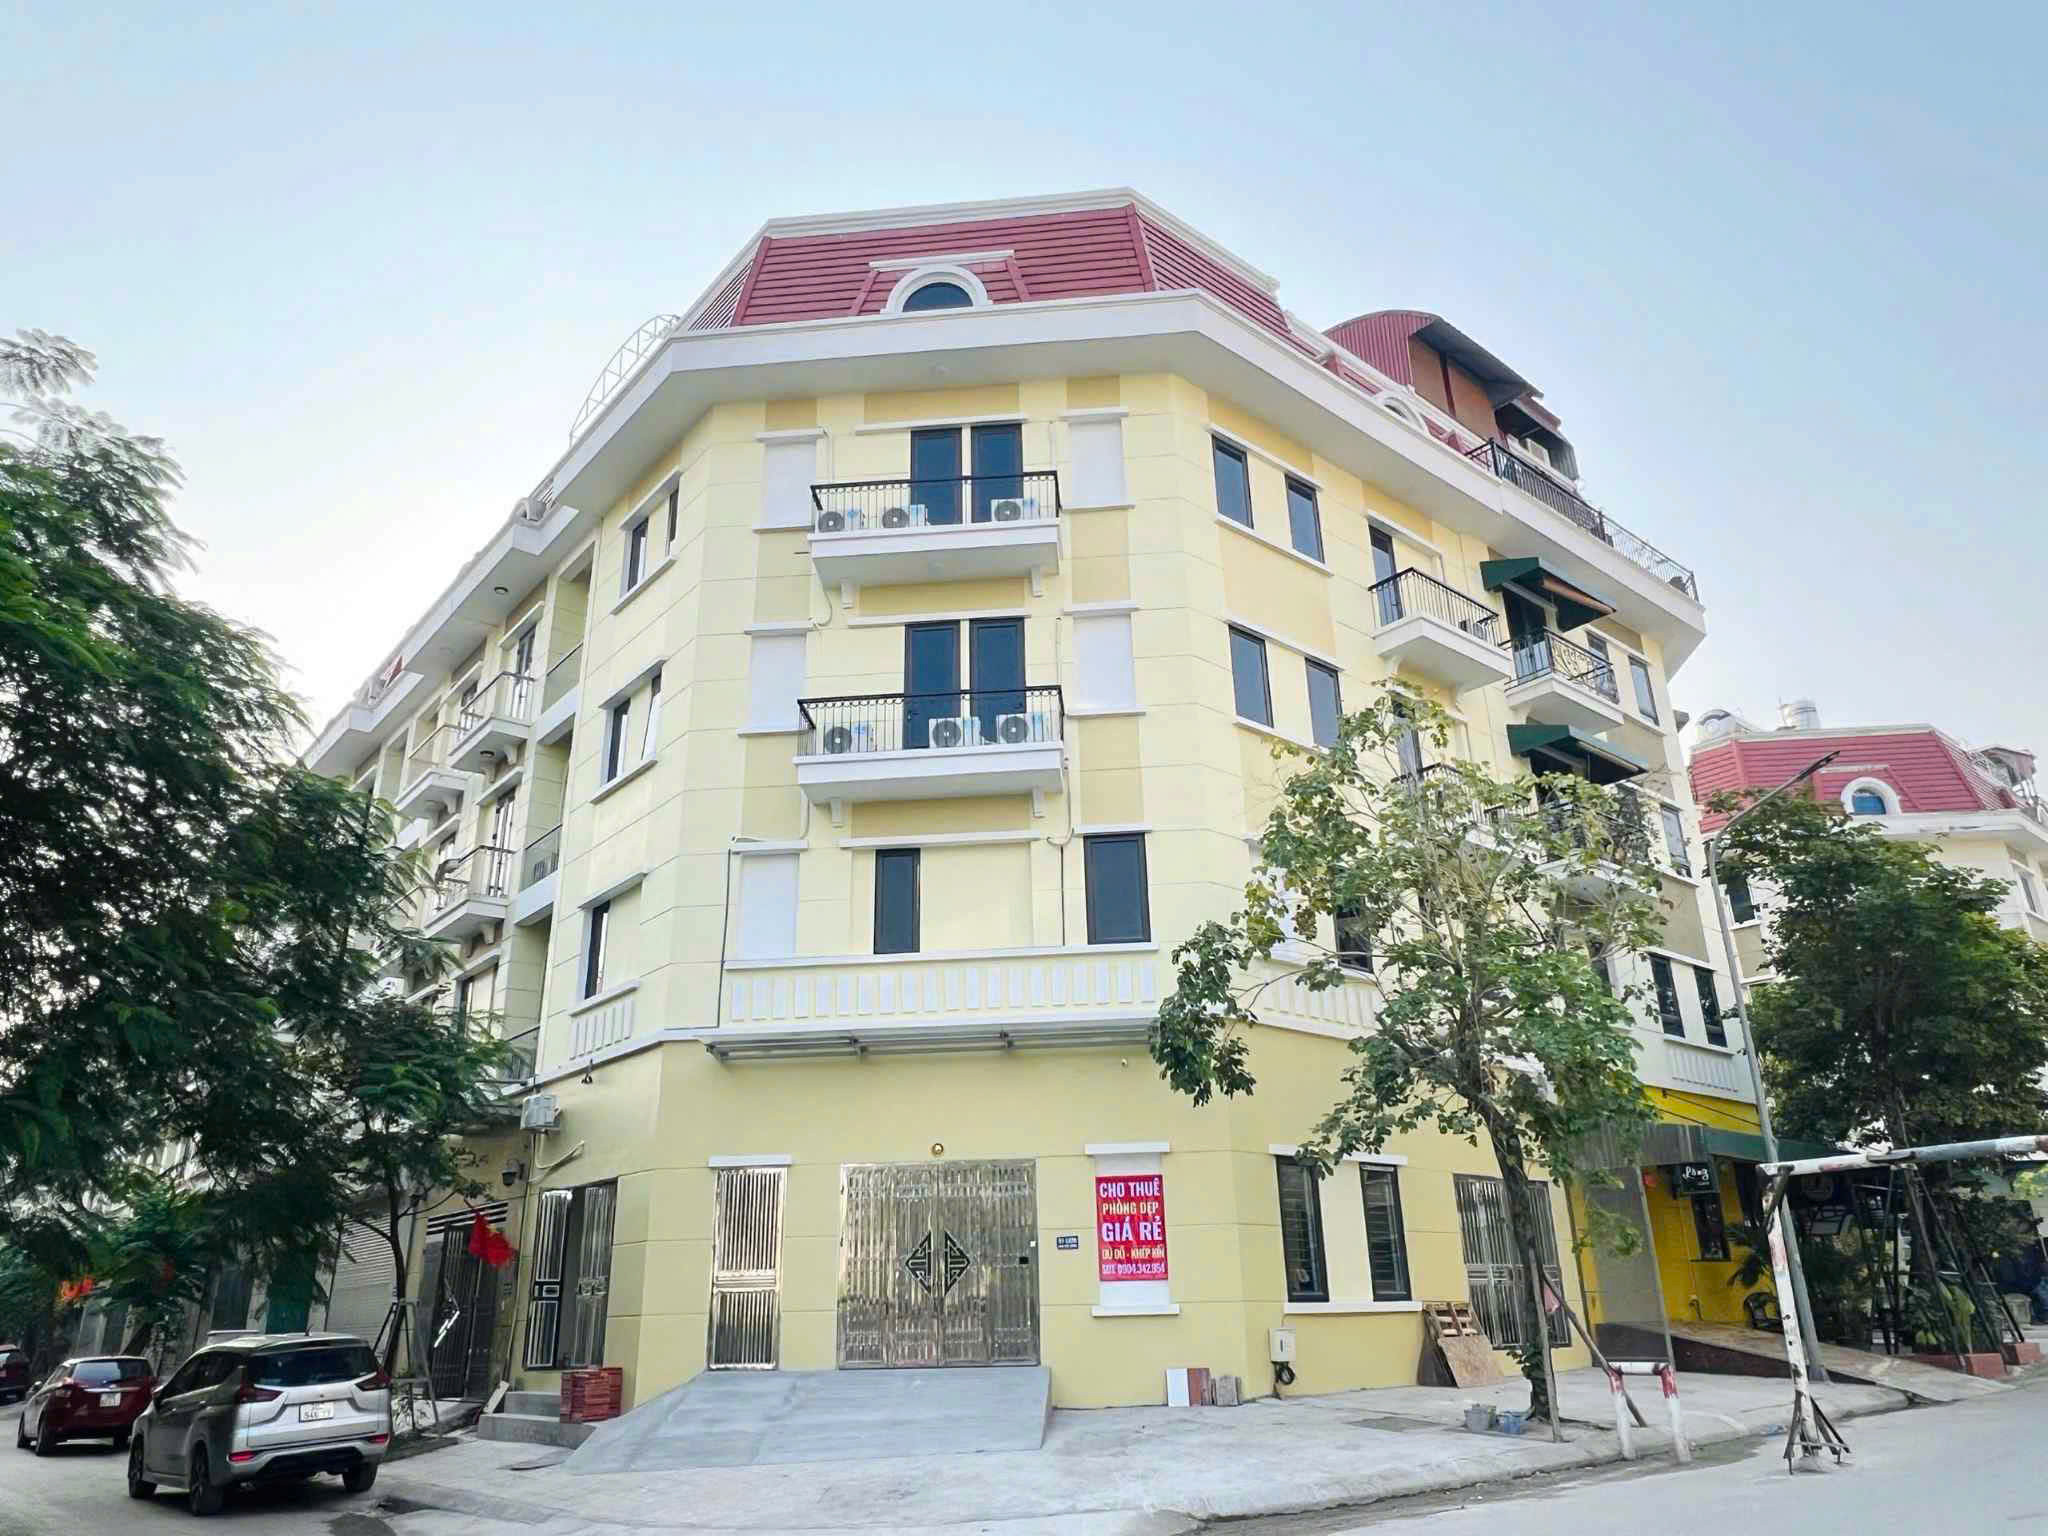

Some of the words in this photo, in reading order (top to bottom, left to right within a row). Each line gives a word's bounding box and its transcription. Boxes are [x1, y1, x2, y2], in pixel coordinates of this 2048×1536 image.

[1100, 1182, 1125, 1198] CHO
[1128, 1177, 1161, 1197] THUÊ
[1102, 1198, 1137, 1215] PHÒNG
[1102, 1216, 1132, 1242] GIÁ
[1139, 1216, 1163, 1241] RẺ
